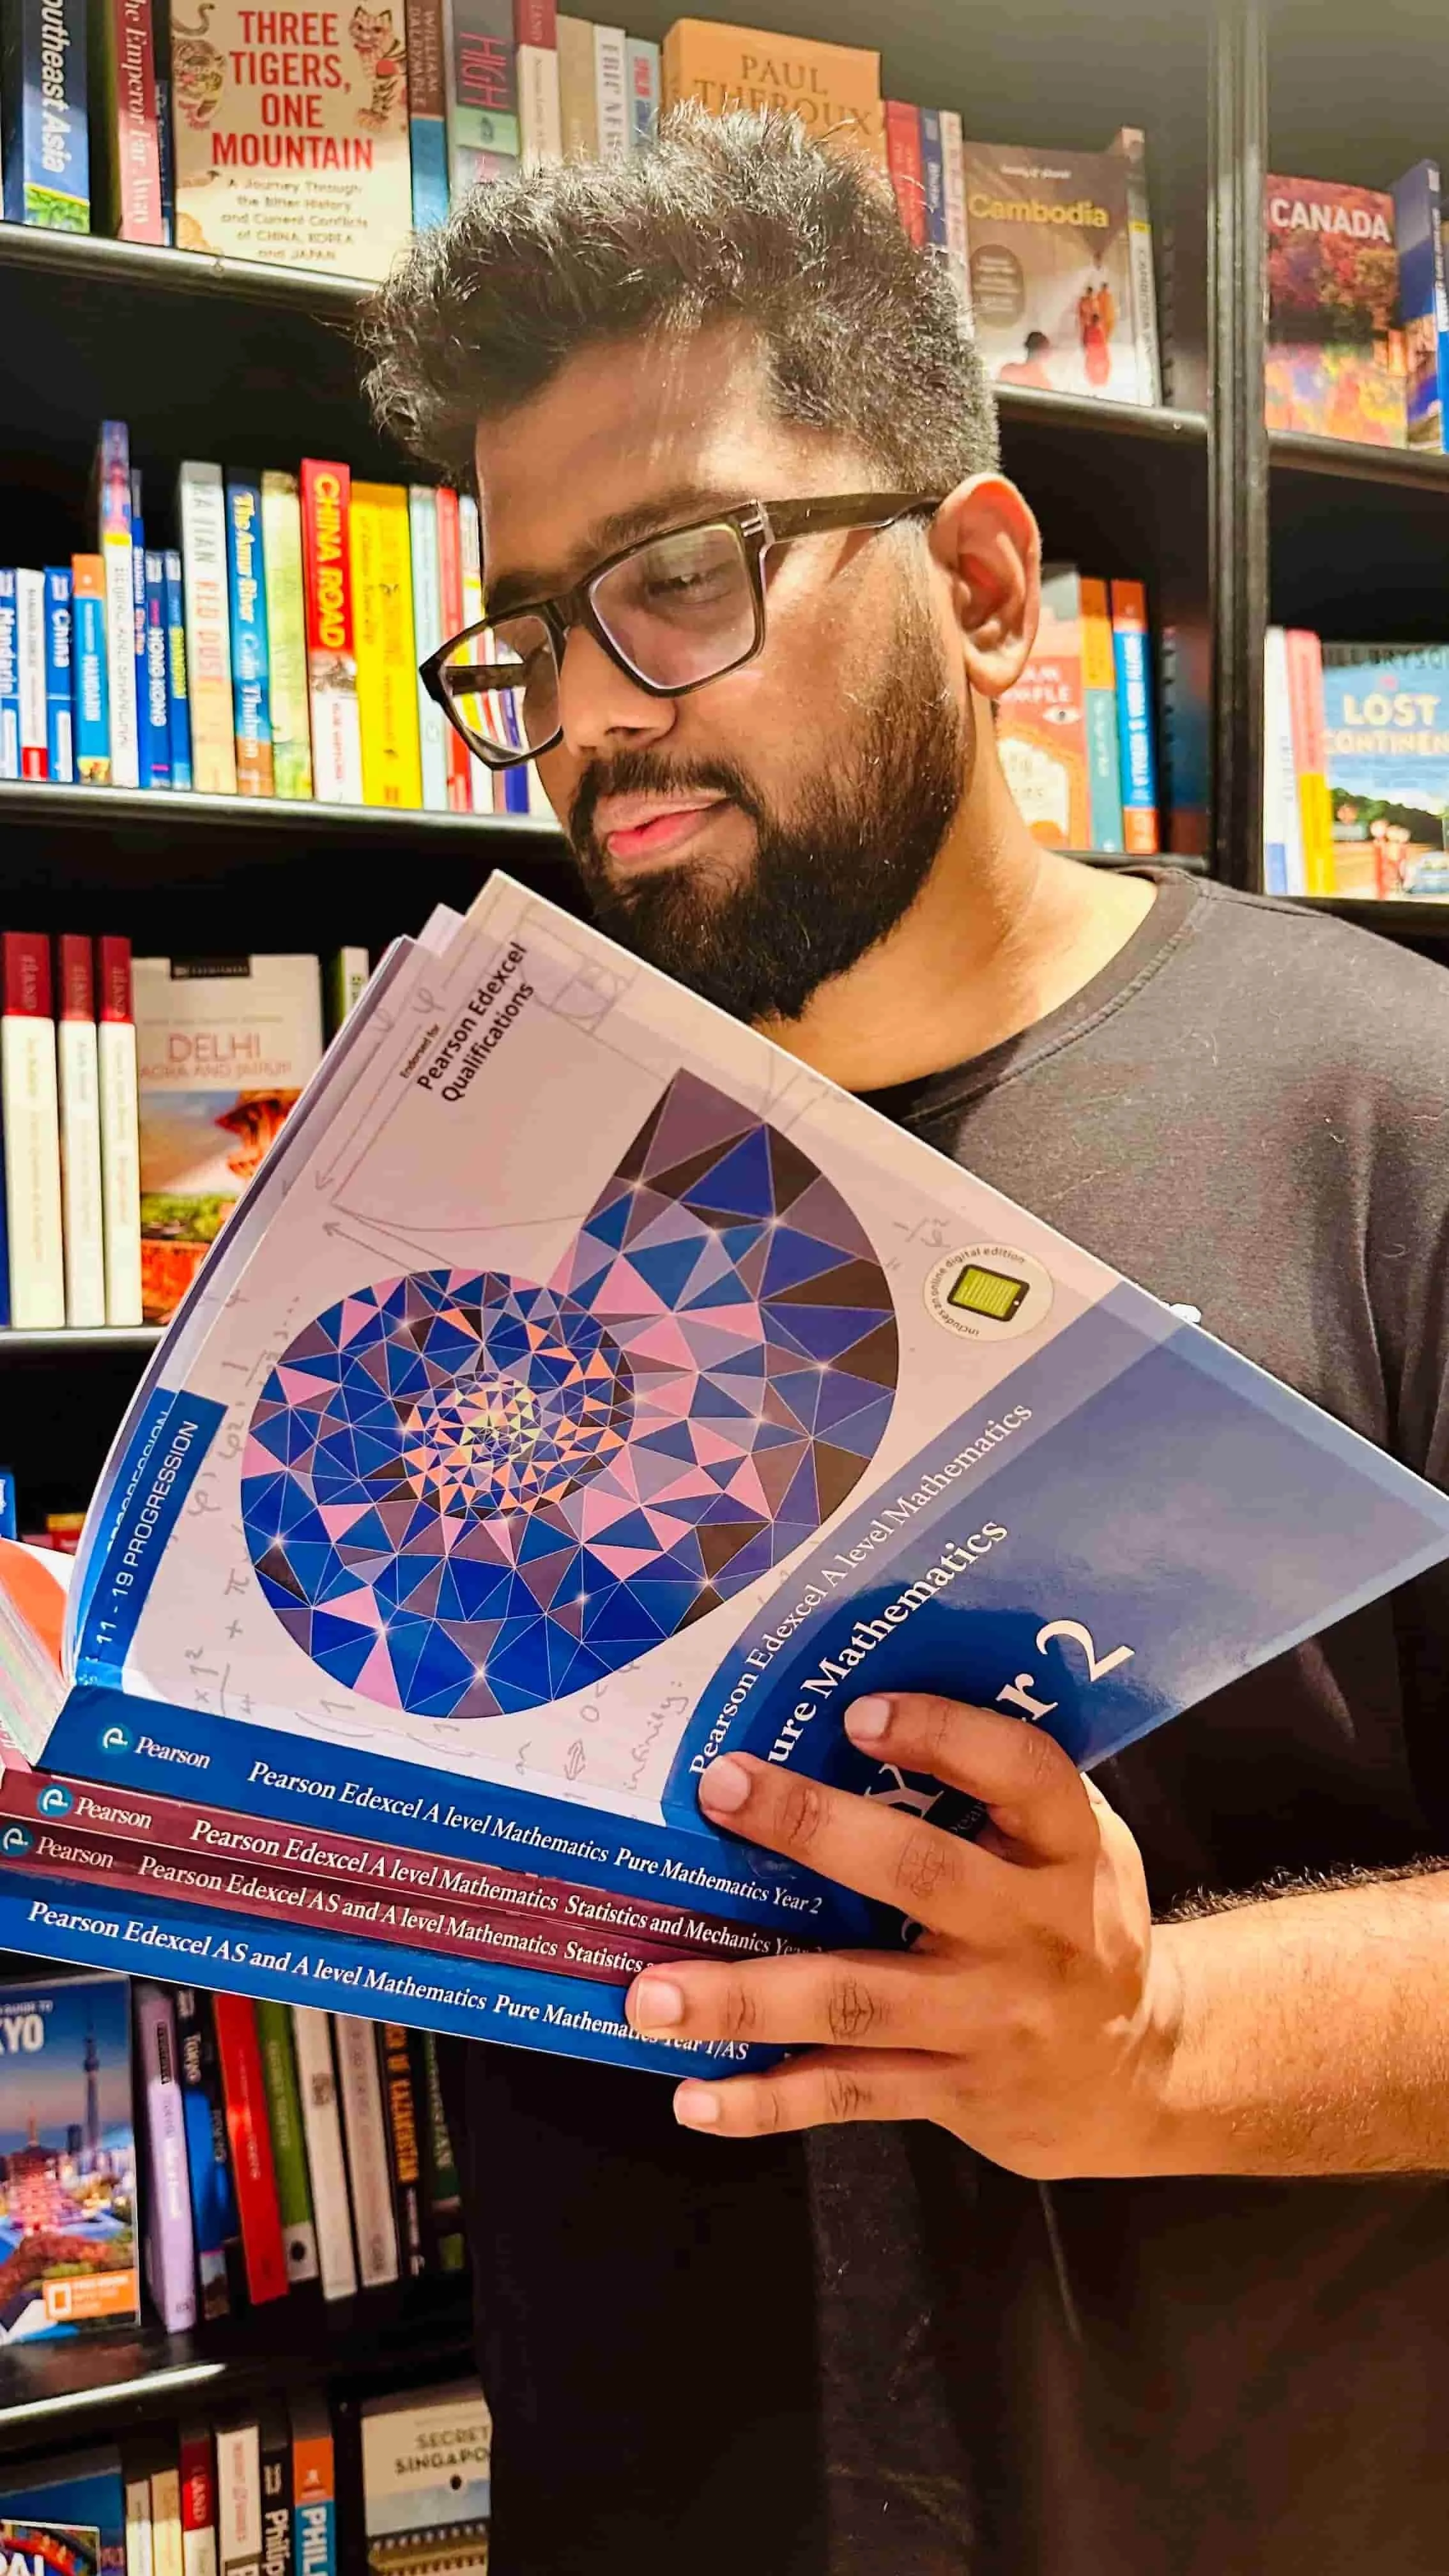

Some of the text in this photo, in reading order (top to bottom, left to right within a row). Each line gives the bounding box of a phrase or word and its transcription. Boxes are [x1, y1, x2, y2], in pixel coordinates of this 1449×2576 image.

[238, 10, 340, 47] THREE
[229, 51, 351, 94] TIGERS,
[408, 6, 426, 108] DALRYMPLE
[424, 10, 439, 93] WILLIAM
[460, 33, 509, 109] HIGH
[121, 27, 148, 124] Emperor
[740, 54, 828, 96] PAUL
[261, 93, 323, 128] ONE
[42, 114, 72, 173] Asia
[129, 129, 152, 167] Far
[211, 132, 374, 172] MOUNTAIN
[228, 178, 363, 196] A Journey Through
[236, 195, 353, 212] the Bitter History
[220, 213, 369, 228] and Current Conflicts
[969, 194, 1110, 228] Cambodia
[1269, 198, 1392, 243] CANADA
[236, 230, 251, 240] of
[307, 233, 355, 245] KOREA
[258, 247, 337, 261] and JAPAN
[314, 472, 346, 648] CHINA ROAD
[195, 579, 220, 619] RED
[51, 608, 70, 668] China
[233, 492, 263, 758] The Amur River Colin Thubron
[148, 627, 165, 675] HONG
[197, 629, 224, 694] DUST
[82, 652, 101, 722] MANDARIN
[149, 677, 167, 726] KONG
[1344, 693, 1441, 727] LOST
[417, 940, 528, 1091] Pearson Edexcel
[169, 1033, 261, 1064] DELHI
[400, 1023, 441, 1079] Endorsed for
[441, 982, 535, 1103] Qualifications
[194, 1062, 231, 1080] AND
[946, 1247, 981, 1268] digital
[983, 1246, 1025, 1264] edition
[931, 1264, 947, 1296] online
[936, 1308, 980, 1337] includes
[123, 1420, 199, 1568] PROGRESSION
[112, 1571, 135, 1598] 19
[689, 1404, 1032, 1777] Pearson Edexcel A level Mathematics
[96, 1620, 117, 1644] 11
[767, 1519, 1008, 1765] ure Mathematics
[1035, 1619, 1137, 1683] 2
[134, 1736, 823, 1914] Pearson Pearson Edexcel A level Mathematics Pure Mathematics Year 2
[74, 1797, 153, 1830] Pearson
[189, 1819, 280, 1858] Pearson
[282, 1839, 370, 1876] Edexcel
[369, 1858, 388, 1878] A
[388, 1860, 439, 1889] level
[437, 1866, 558, 1912] Mathematics
[563, 1894, 648, 1929] Statistics
[648, 1913, 684, 1937] and
[683, 1919, 770, 1954] Mechanics
[35, 1836, 643, 1975] Pearson Pearson Edexcel AS and A level Mathematics Statistics
[27, 1900, 121, 1938] Pearson
[121, 1919, 213, 1957] Edexcel
[211, 1939, 250, 1964] AS
[249, 1948, 291, 1974] and
[290, 1955, 312, 1978] A
[312, 1958, 363, 1987] level
[362, 1965, 487, 2011] Mathematics
[493, 1993, 540, 2021] Pure
[415, 2425, 490, 2450] SECRET
